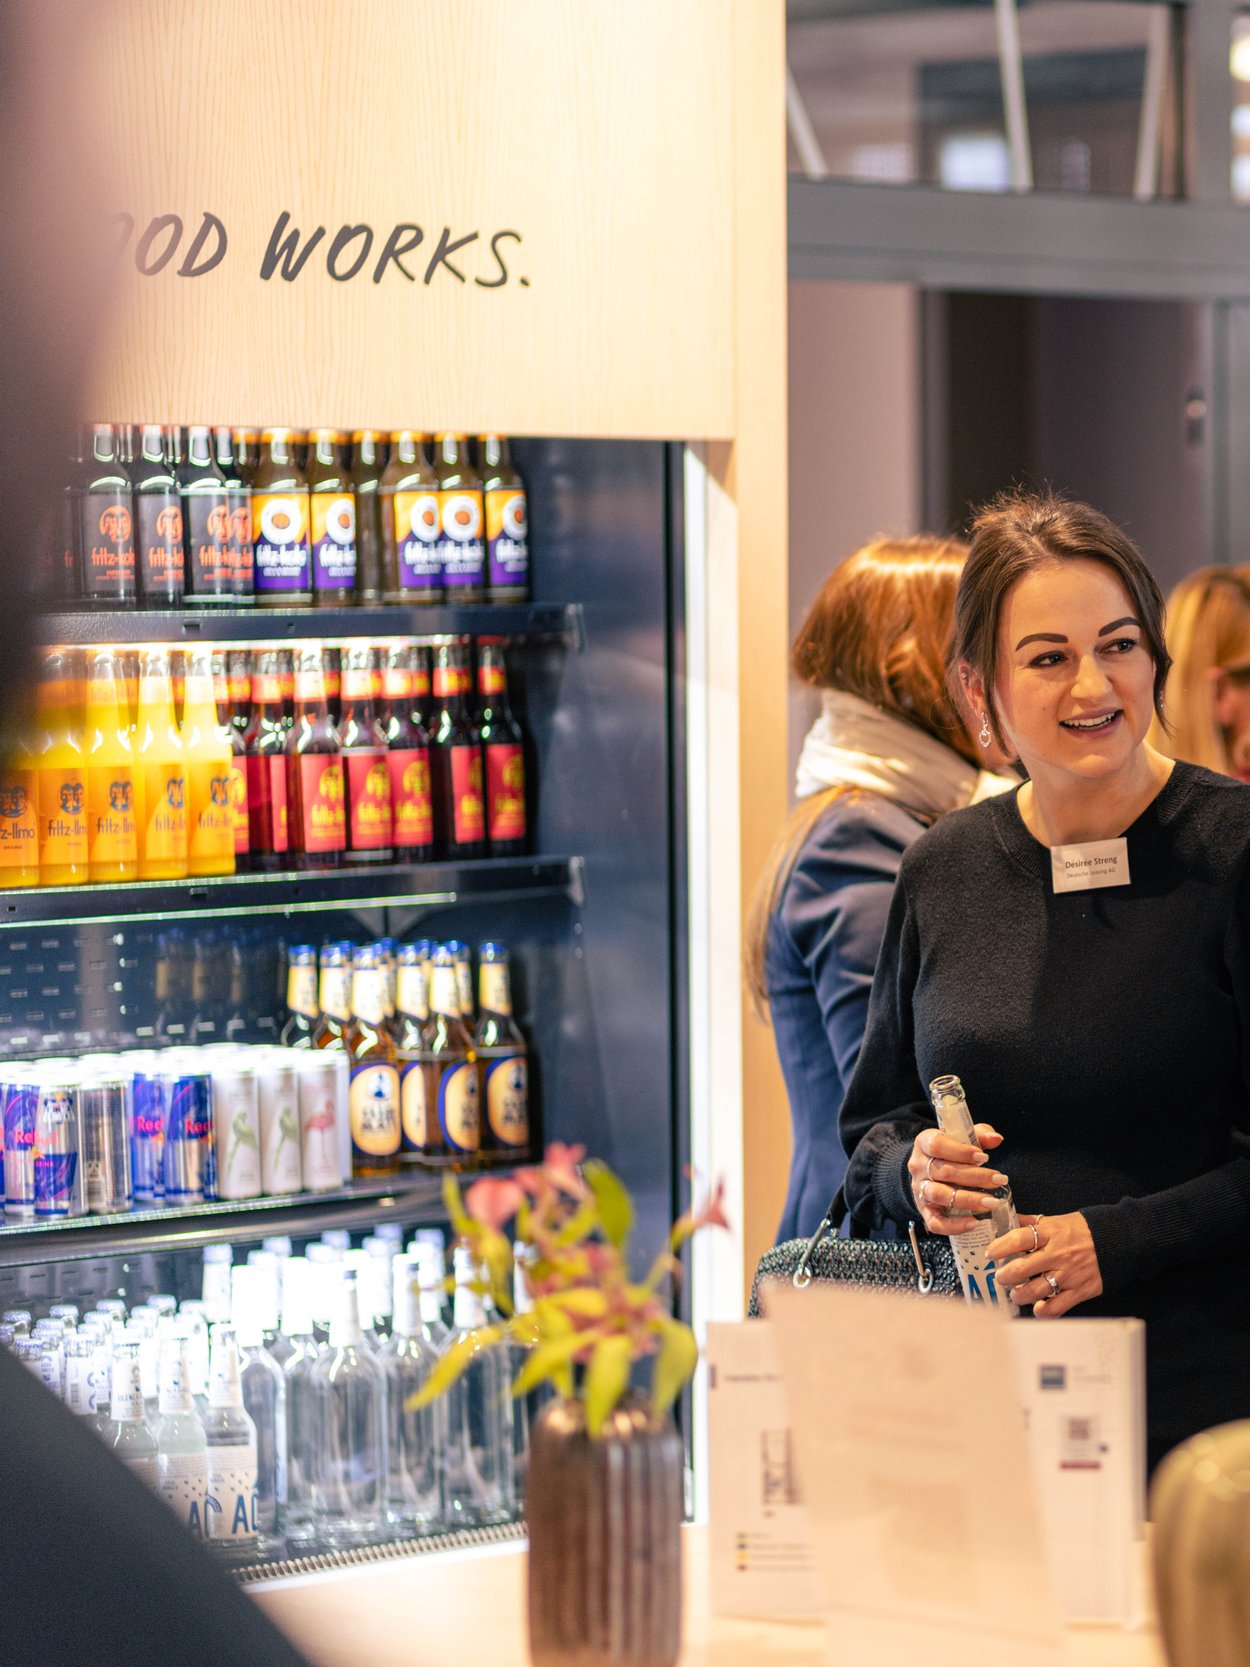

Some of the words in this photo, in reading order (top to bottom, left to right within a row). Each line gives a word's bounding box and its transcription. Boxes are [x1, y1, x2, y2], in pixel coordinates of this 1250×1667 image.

[259, 210, 531, 288] WORKS.
[0, 822, 35, 840] z-limo
[1094, 856, 1118, 865] Streng
